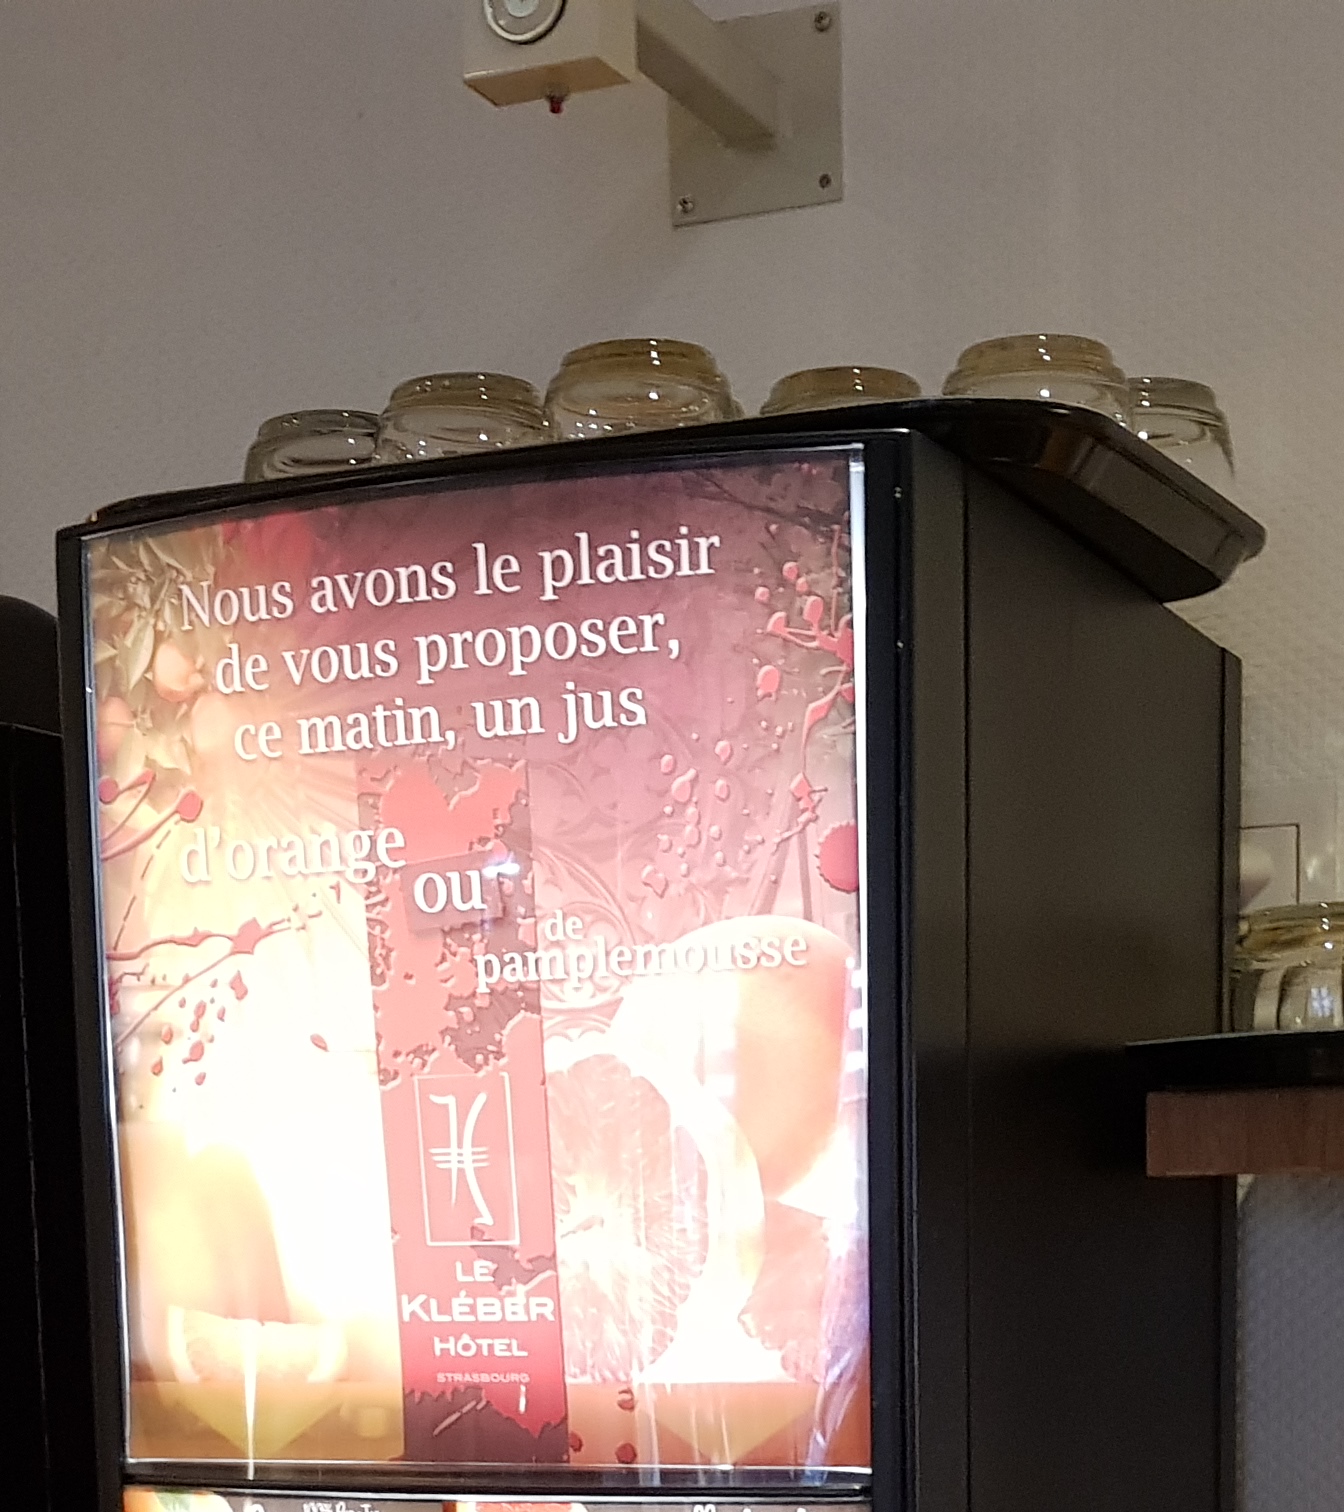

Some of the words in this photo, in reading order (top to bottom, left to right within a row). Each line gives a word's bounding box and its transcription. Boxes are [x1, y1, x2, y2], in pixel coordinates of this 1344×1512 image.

[178, 580, 294, 631] Nous
[310, 561, 457, 613] avons
[472, 542, 521, 595] le
[537, 525, 721, 601] plaisir
[215, 643, 270, 694] de
[282, 638, 399, 685] vous
[414, 612, 680, 685] proposer,
[234, 719, 282, 760] ce
[297, 697, 455, 754] matin,
[471, 694, 545, 738] un
[557, 681, 647, 744] jus
[179, 824, 406, 884] d'orange
[413, 868, 486, 914] ou
[544, 909, 584, 942] de
[474, 933, 809, 993] pamplemousse
[455, 1259, 495, 1282] LE
[401, 1289, 556, 1323] KLÉBER
[433, 1333, 529, 1358] HÔTEL
[436, 1372, 531, 1384] STRASBOURG
